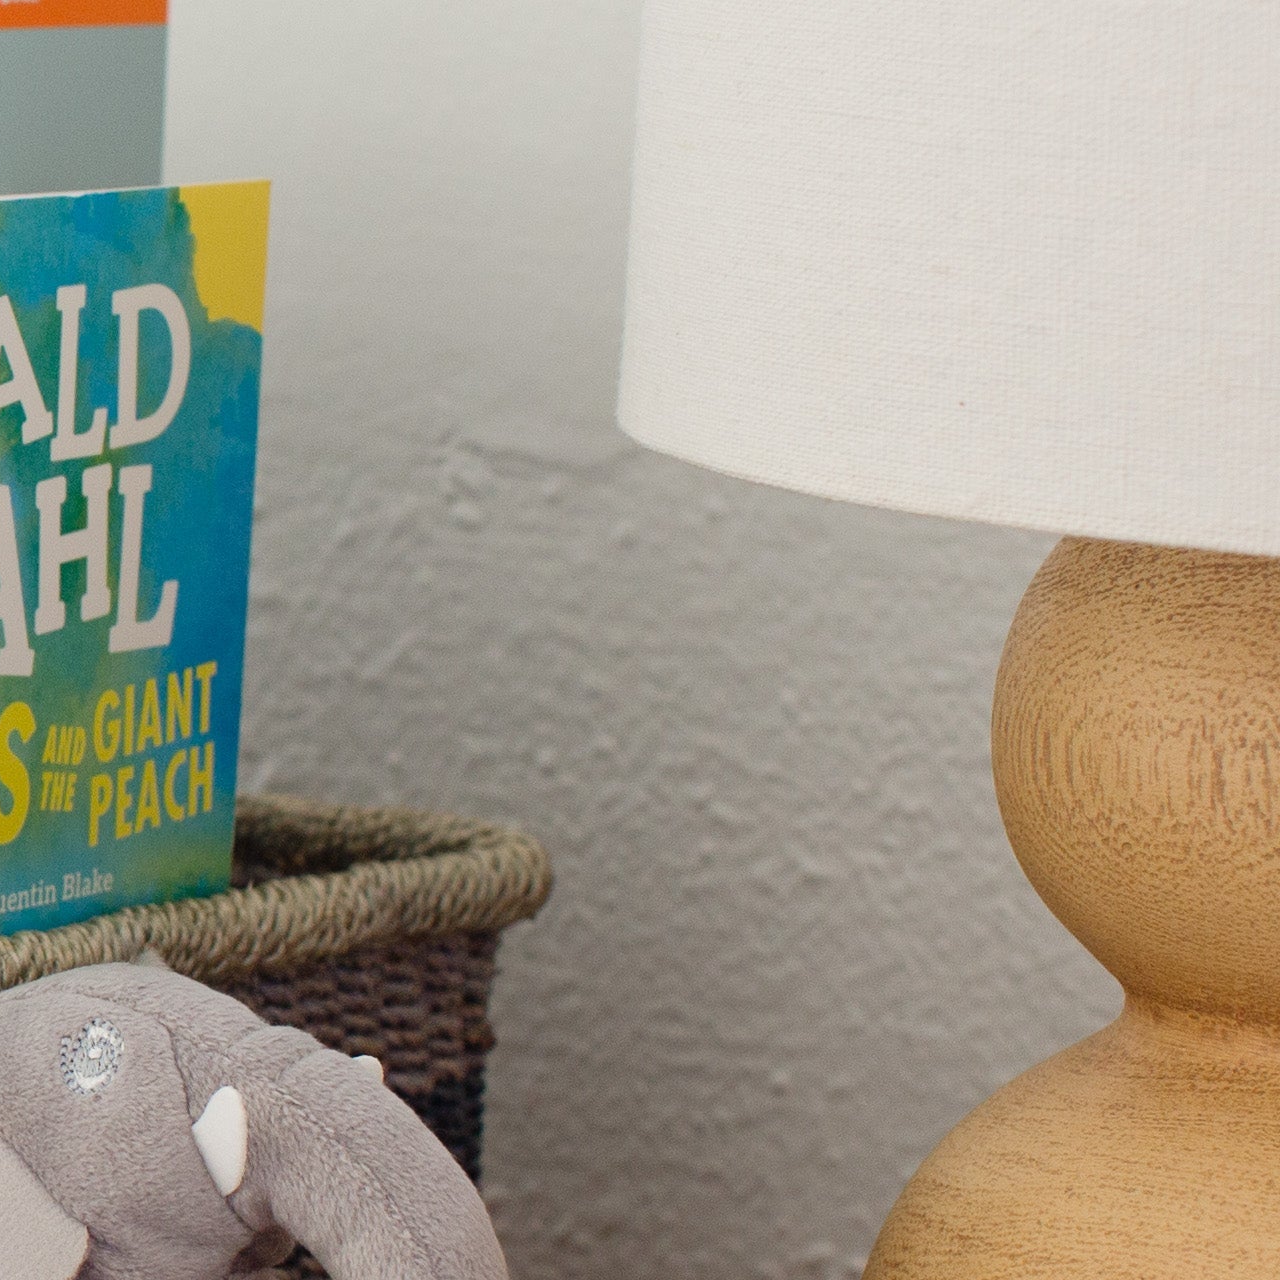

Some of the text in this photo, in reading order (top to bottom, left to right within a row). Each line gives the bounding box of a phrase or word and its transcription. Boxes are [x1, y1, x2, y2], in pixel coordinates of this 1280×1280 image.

[93, 661, 217, 763] GIANT
[43, 725, 85, 766] AND
[41, 771, 75, 812] THE
[89, 742, 215, 847] PEACH
[62, 870, 113, 902] Blake
